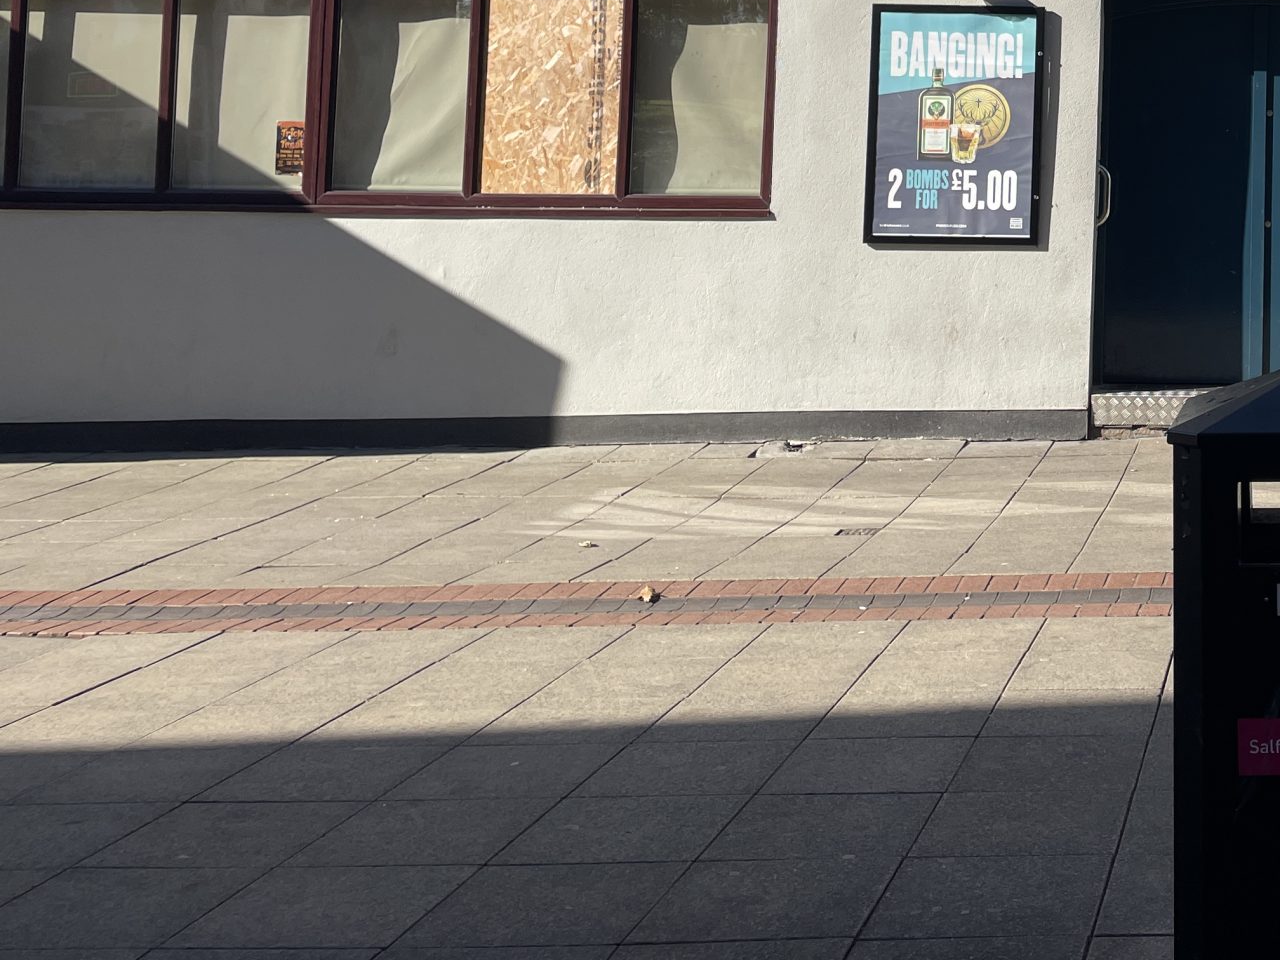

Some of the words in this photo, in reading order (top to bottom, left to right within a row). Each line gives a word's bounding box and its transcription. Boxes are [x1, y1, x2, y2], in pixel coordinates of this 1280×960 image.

[890, 30, 1024, 79] BANGING!
[887, 168, 903, 209] 2
[906, 169, 949, 190] BOMBS
[915, 190, 938, 209] FOR
[951, 168, 1018, 211] £5.00
